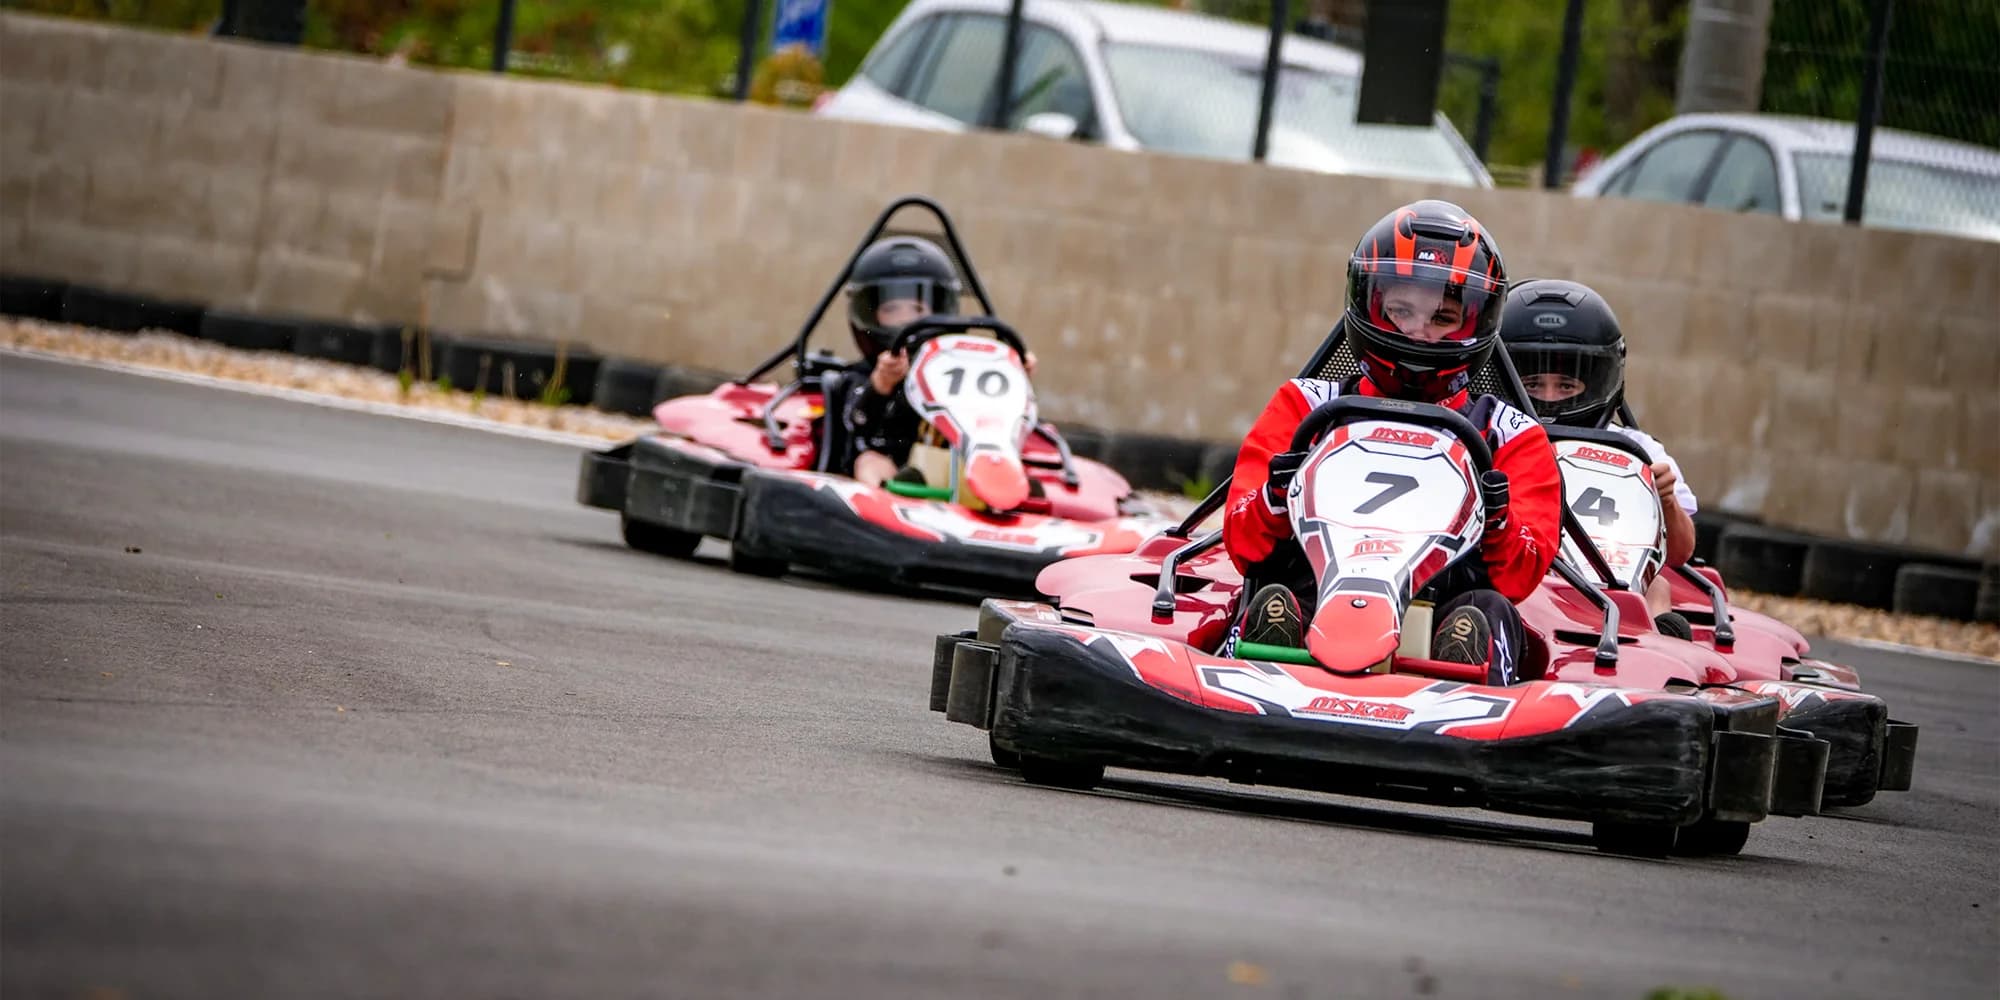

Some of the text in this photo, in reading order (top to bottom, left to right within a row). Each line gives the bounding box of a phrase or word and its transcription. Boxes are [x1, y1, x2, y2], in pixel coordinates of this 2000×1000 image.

[944, 367, 1009, 397] 10
[1353, 471, 1419, 514] 7
[1571, 487, 1619, 526] 4
